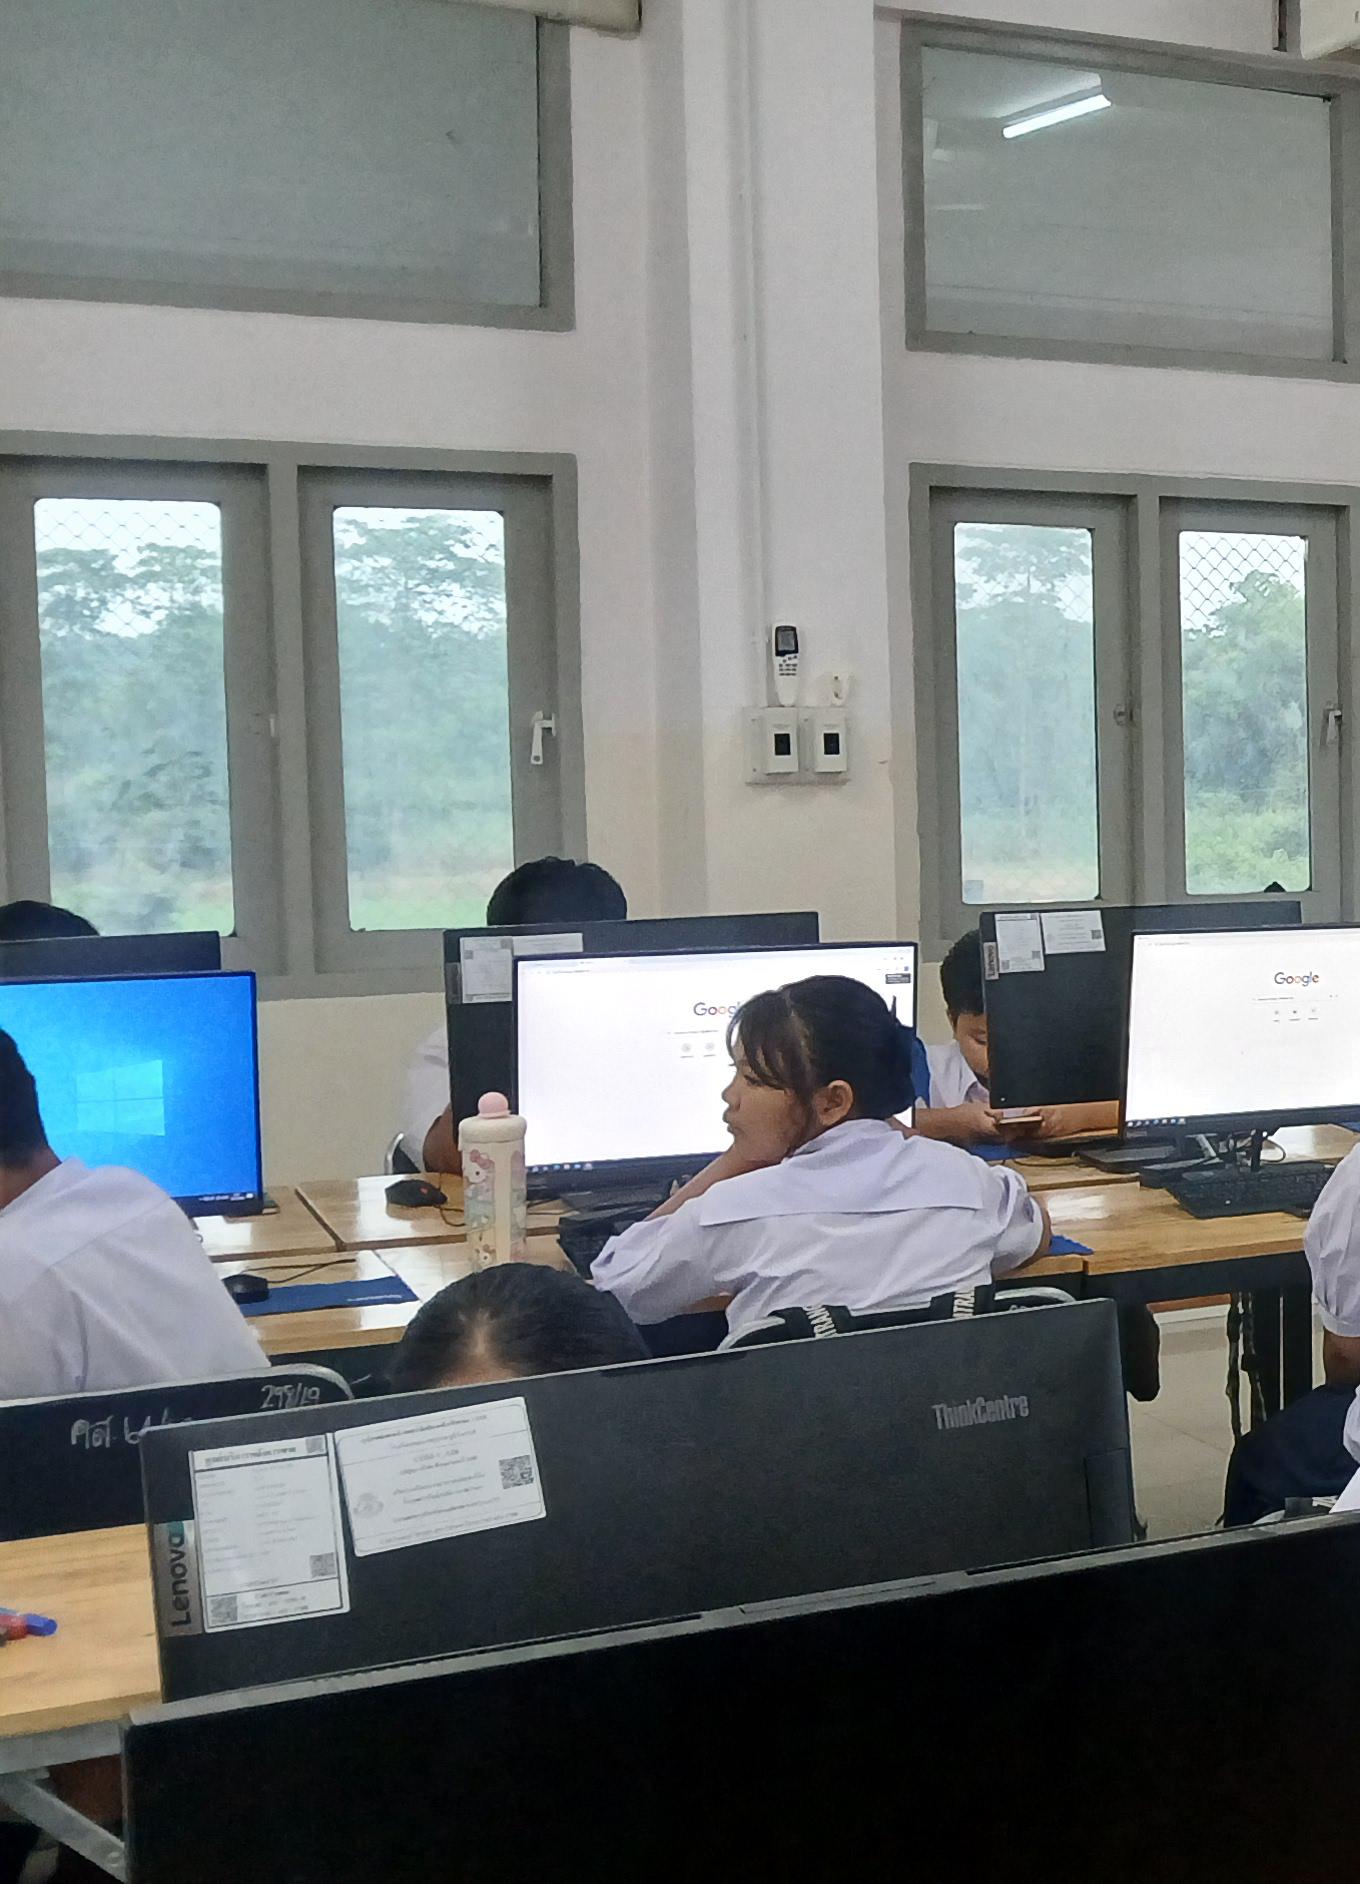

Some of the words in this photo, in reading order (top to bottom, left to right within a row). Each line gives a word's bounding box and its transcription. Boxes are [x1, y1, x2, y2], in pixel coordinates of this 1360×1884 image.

[1274, 971, 1320, 987] Google
[693, 1001, 744, 1018] Goog
[931, 1394, 1030, 1431] ThinkCentre
[170, 1529, 192, 1628] Lenovo
